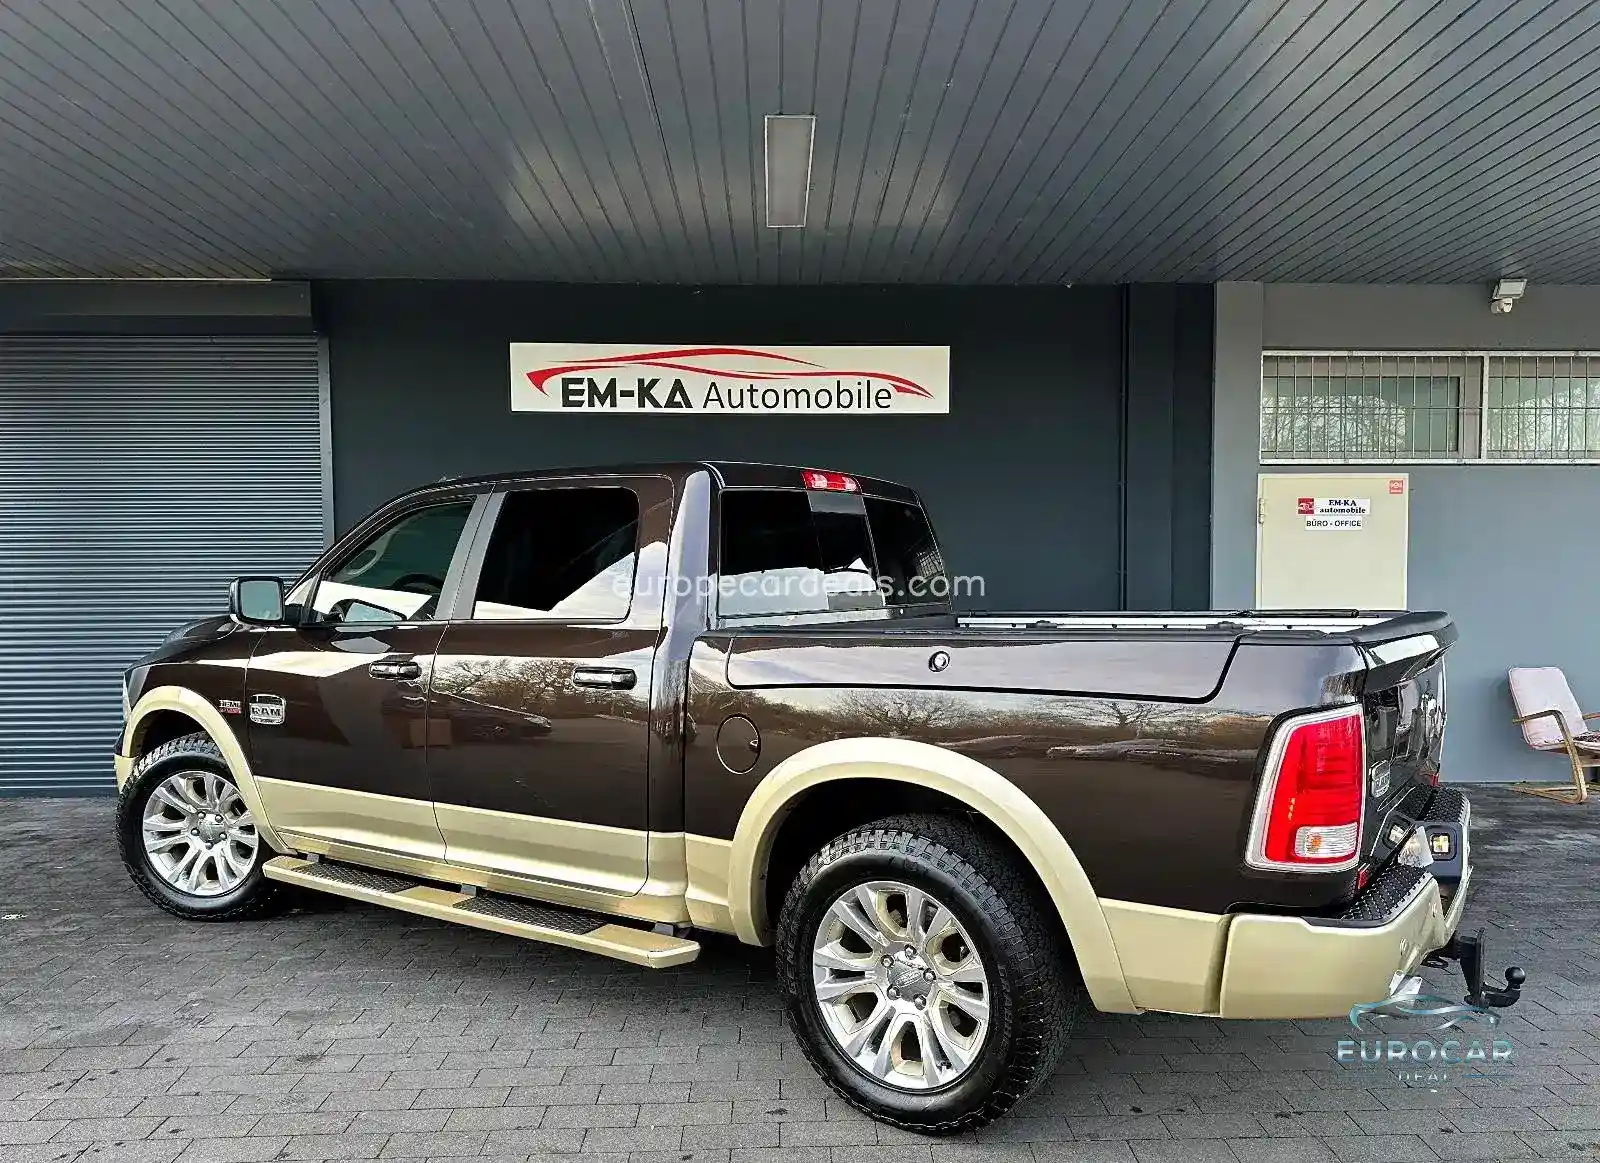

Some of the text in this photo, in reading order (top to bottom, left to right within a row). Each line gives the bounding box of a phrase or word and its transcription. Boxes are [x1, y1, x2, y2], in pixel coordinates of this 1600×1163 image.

[562, 377, 892, 410] EM-KA Automobile
[1329, 499, 1356, 507] EM-KA
[1306, 518, 1328, 527] BÜRO
[251, 706, 282, 717] RAM
